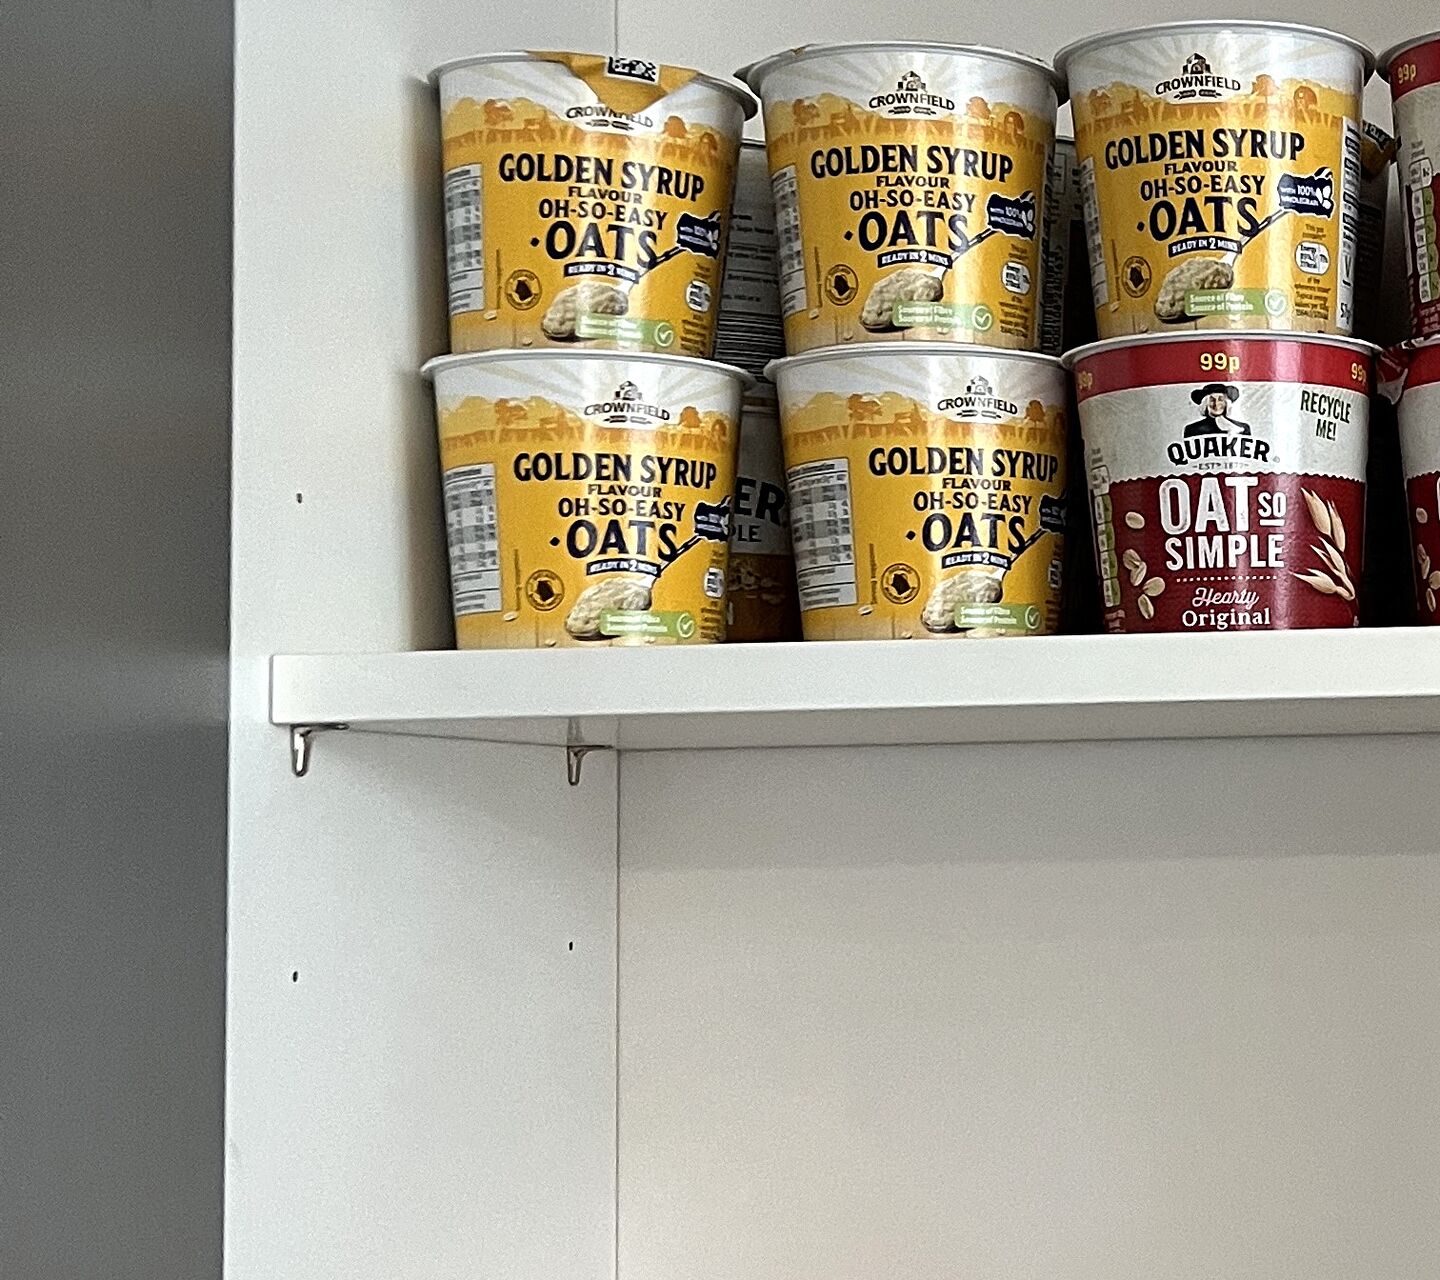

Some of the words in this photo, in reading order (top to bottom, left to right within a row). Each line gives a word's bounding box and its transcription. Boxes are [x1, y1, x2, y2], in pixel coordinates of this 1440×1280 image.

[1398, 64, 1416, 84] 99p
[1156, 76, 1240, 96] CROWNFIELD
[869, 91, 955, 111] CROWNFIELD
[1105, 129, 1201, 170] GOLDEN
[1212, 129, 1304, 161] SYRUP
[811, 144, 917, 179] GOLDEN
[926, 145, 1013, 183] SYRUP
[1164, 160, 1238, 175] FLAVOUR
[499, 153, 613, 186] GOLDEN
[621, 161, 704, 203] SYRUP
[876, 175, 950, 189] FLAVOUR
[1140, 175, 1265, 201] OH-SO-EASY
[568, 186, 642, 205] FLAVOUR
[850, 190, 975, 212] OH-SO-EASY
[1296, 184, 1316, 197] 100%
[539, 199, 667, 230] OH-SO-EASY
[1150, 197, 1260, 241] OATS
[858, 210, 969, 252] OATS
[545, 221, 658, 269] OATS
[920, 250, 928, 263] 2
[1172, 240, 1197, 254] READY
[1209, 238, 1216, 249] 2
[1217, 240, 1238, 250] MINS
[1200, 353, 1241, 374] 99p
[584, 401, 670, 422] CROWNFIELD
[937, 397, 1018, 415] CROWNFIELD
[1301, 390, 1351, 424] RECYCLE
[1316, 418, 1337, 441] ME!
[1167, 437, 1270, 467] QUAKER
[513, 452, 632, 483] GOLDEN
[640, 456, 716, 490] SYRUP
[869, 447, 984, 477] GOLDEN
[992, 447, 1058, 483] SYRUP
[588, 484, 662, 498] FLAVOUR
[942, 477, 1011, 491] FLAVOUR
[558, 498, 685, 522] OH-SO-EASY
[914, 491, 1032, 515] OH-SO-EASY
[1159, 477, 1258, 535] OAT
[1258, 492, 1286, 517] SO
[567, 519, 678, 562] OATS
[922, 513, 1026, 553] OATS
[1166, 535, 1285, 571] SIMPLE
[1192, 588, 1259, 609] Hearty
[1182, 608, 1270, 630] Original
